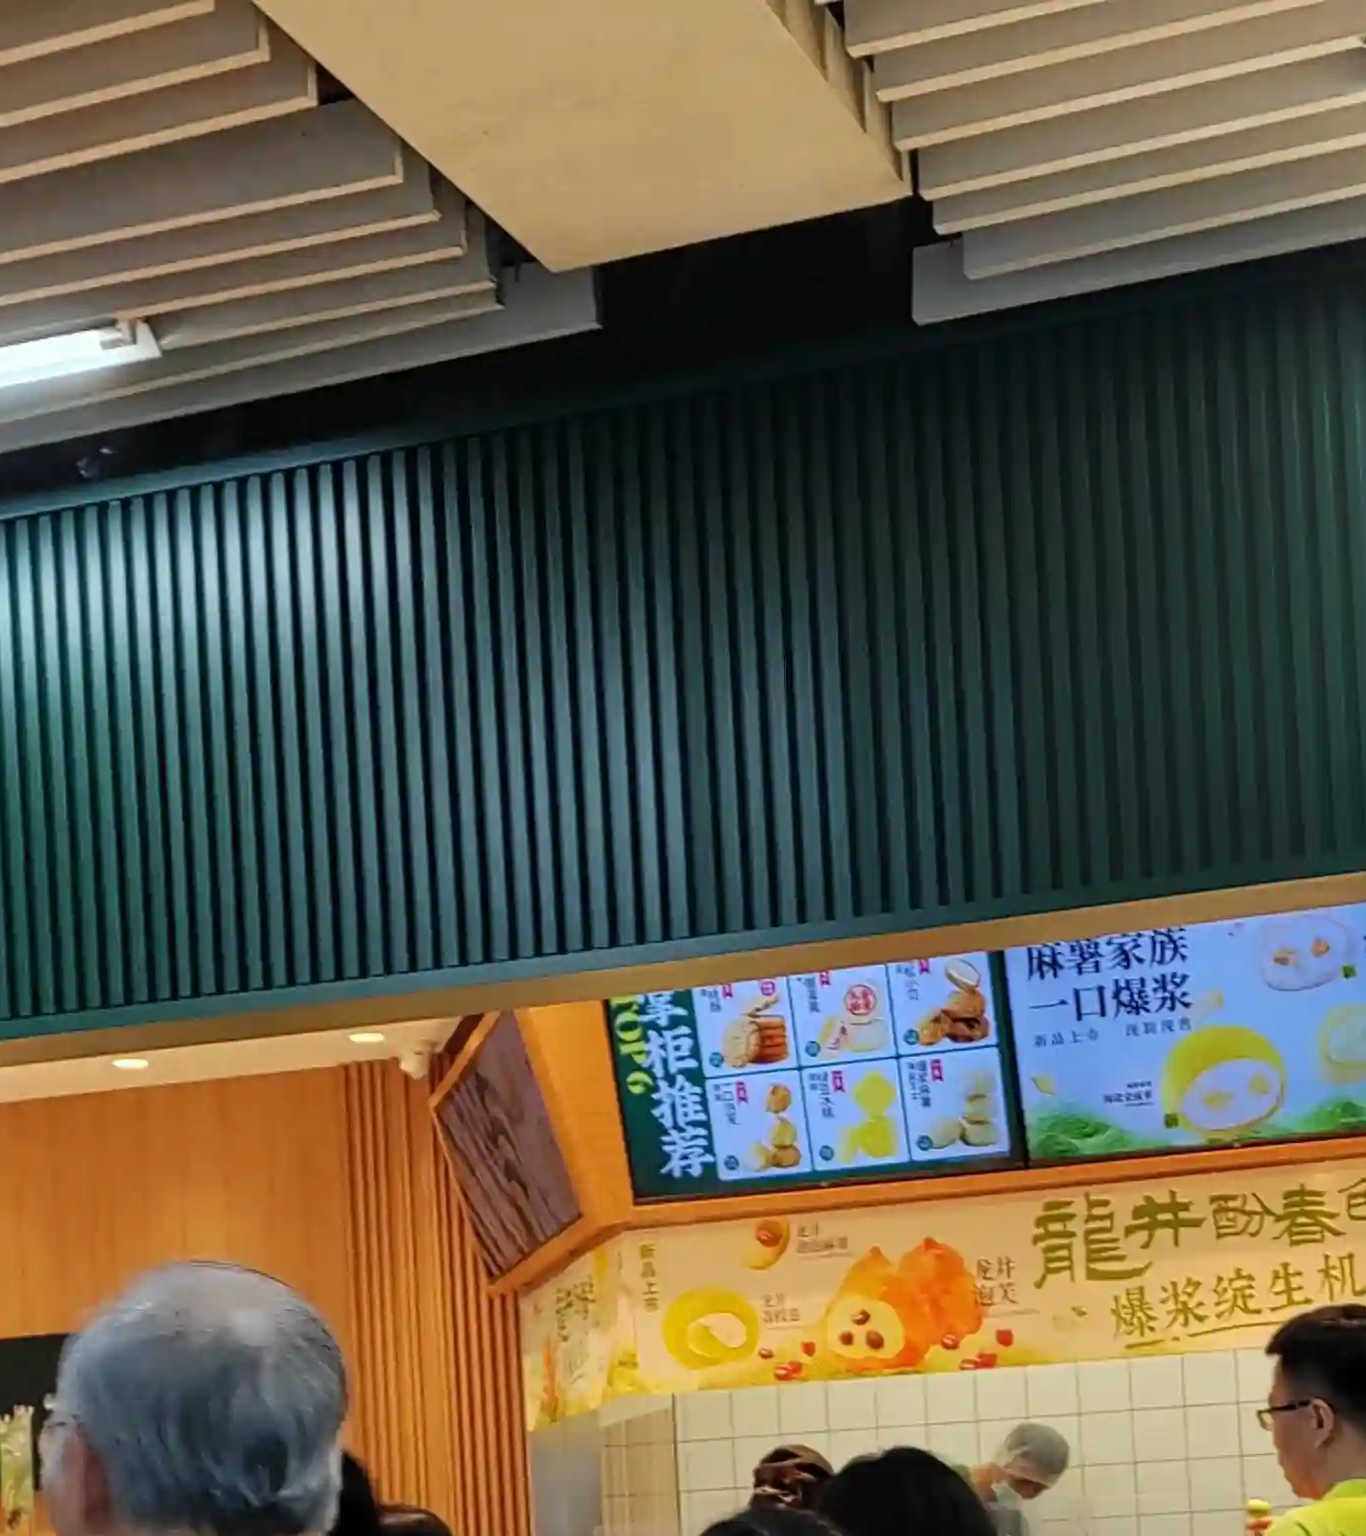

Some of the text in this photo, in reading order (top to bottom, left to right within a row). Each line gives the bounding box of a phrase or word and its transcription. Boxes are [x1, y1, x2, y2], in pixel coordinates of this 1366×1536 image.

[1026, 927, 1189, 981] 麻薯家族
[1029, 972, 1193, 1022] 一口爆浆
